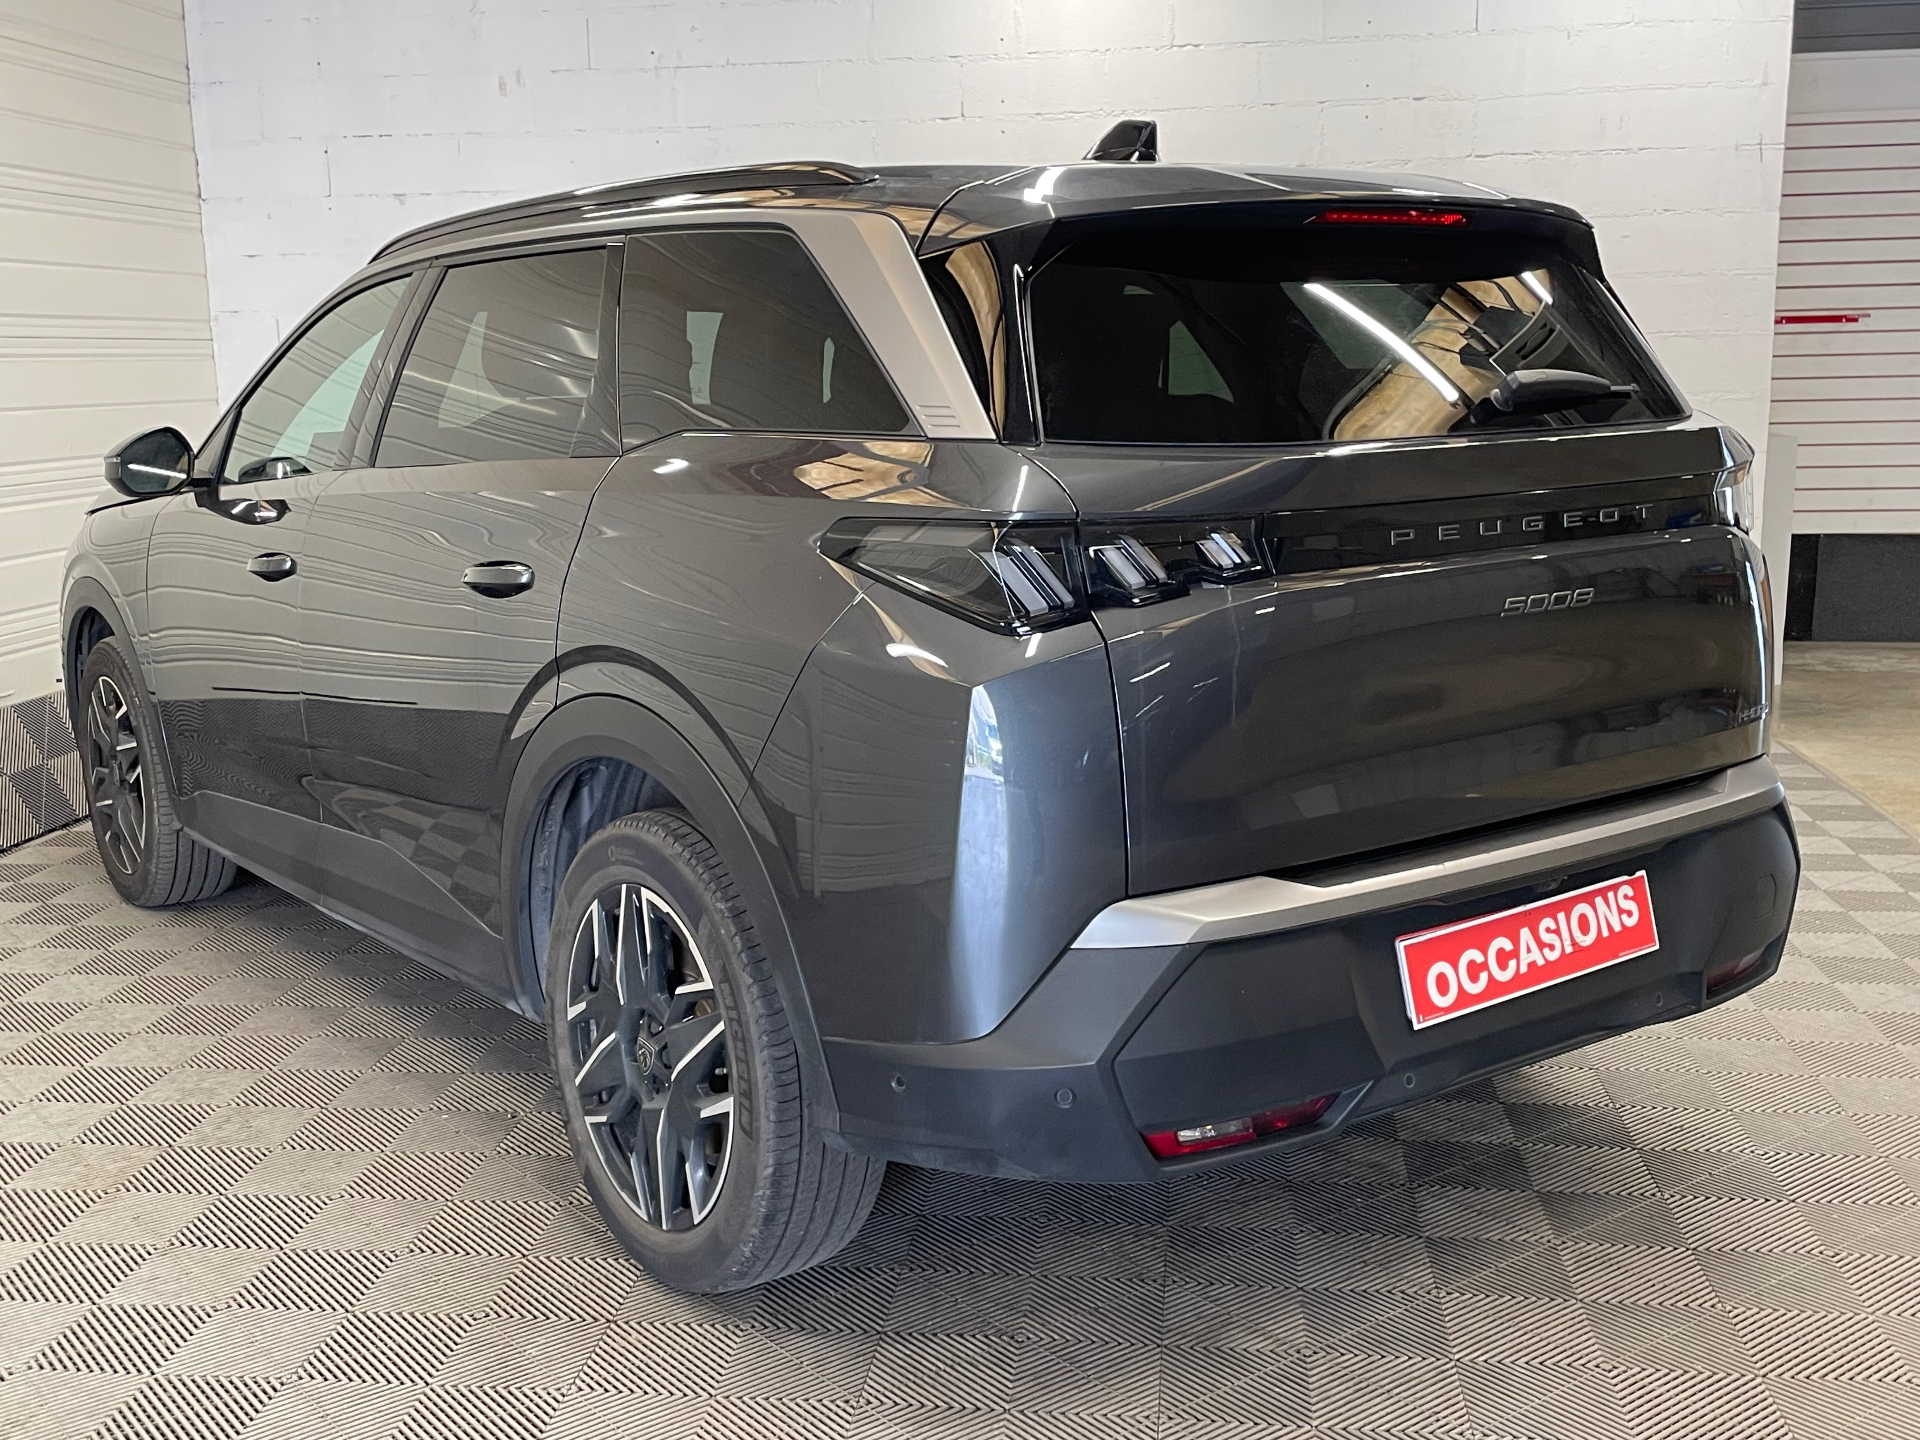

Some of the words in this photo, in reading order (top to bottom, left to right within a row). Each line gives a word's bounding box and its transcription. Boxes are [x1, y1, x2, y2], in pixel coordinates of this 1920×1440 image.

[1390, 504, 1654, 546] PEUGEOT
[1501, 587, 1595, 617] 5008
[1427, 884, 1640, 1008] OCCASIONS
